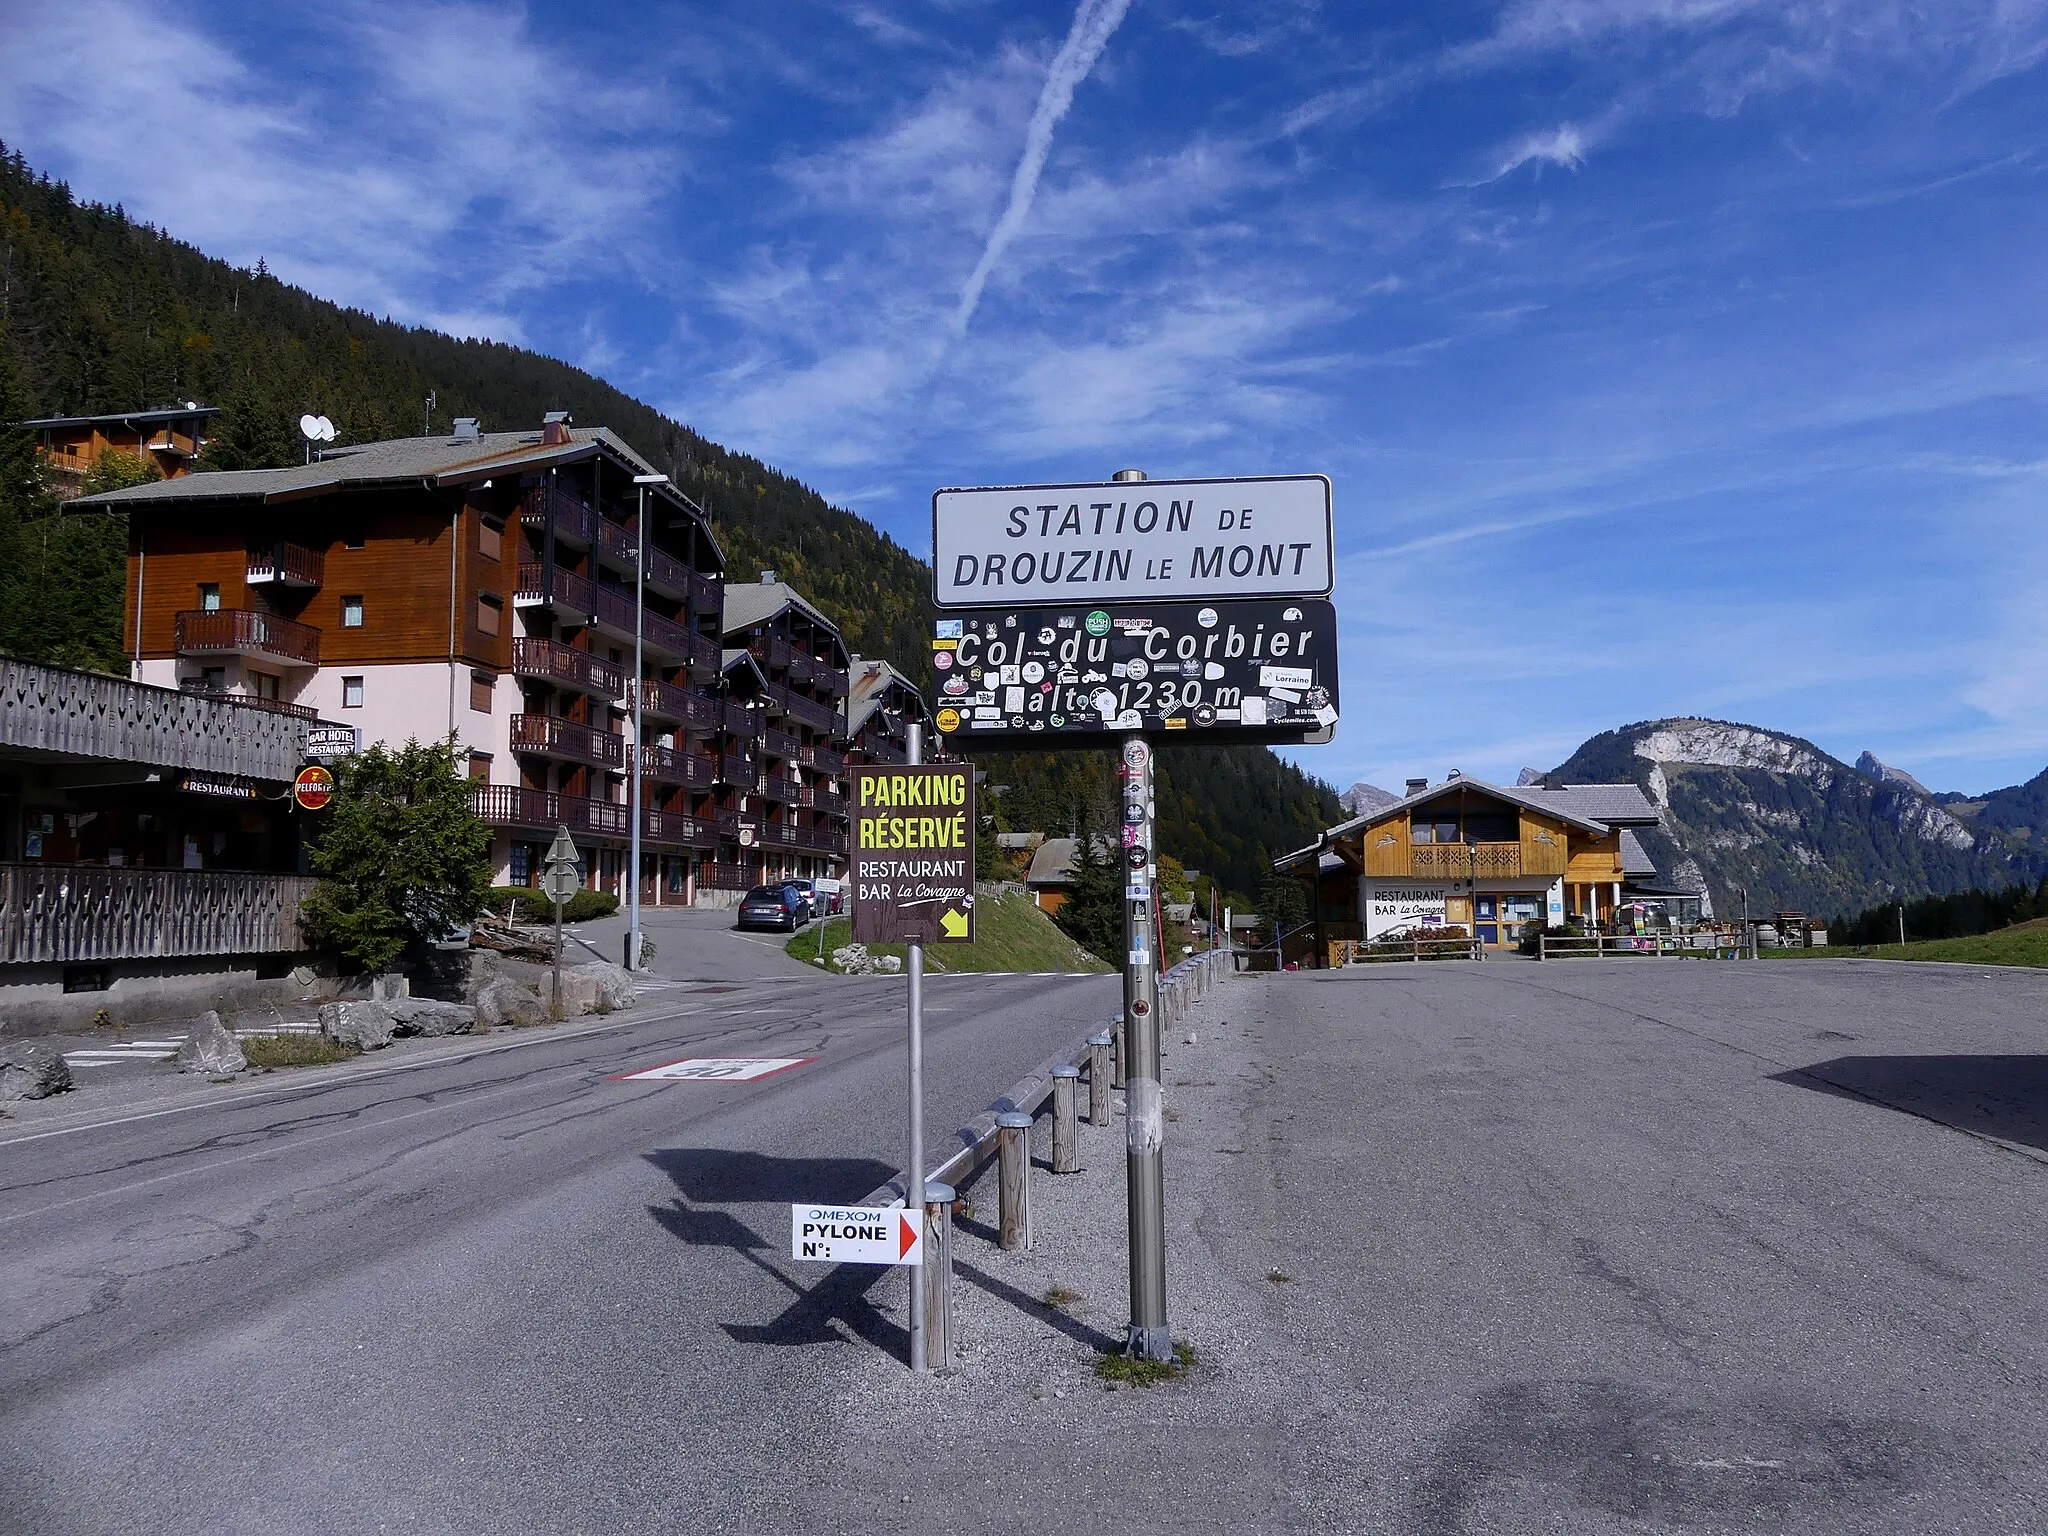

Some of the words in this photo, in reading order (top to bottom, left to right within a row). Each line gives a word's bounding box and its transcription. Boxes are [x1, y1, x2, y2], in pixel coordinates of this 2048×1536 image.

[1005, 500, 1194, 538] STATION
[1217, 508, 1254, 532] DE
[952, 549, 1133, 587] DROUZIN
[1145, 558, 1173, 581] LE
[1189, 542, 1313, 579] MONT
[955, 631, 1026, 667] Col
[1059, 630, 1108, 663] du
[1144, 623, 1313, 661] Corbier
[1275, 675, 1310, 684] Lorraine
[1119, 680, 1202, 710] 1230
[1214, 686, 1241, 707] m
[309, 731, 326, 743] BAR
[327, 730, 355, 743] HOTEL
[308, 745, 355, 754] RESTAURANT
[189, 781, 250, 797] RESTAURANT
[860, 774, 966, 807] PARKING
[859, 811, 966, 849] RÉSERVÉ
[859, 860, 966, 878] RESTAURANT
[859, 883, 891, 900] BAR
[897, 883, 913, 898] La
[915, 883, 966, 903] Covagne
[1374, 890, 1445, 902] RESTAURANT
[1375, 905, 1396, 915] BAR
[1400, 905, 1411, 914] La
[1412, 904, 1446, 915] Covagne
[662, 1067, 744, 1078] 30
[809, 1209, 882, 1222] OMEXOM
[802, 1223, 887, 1241] PYLONE
[802, 1242, 831, 1258] N°:
